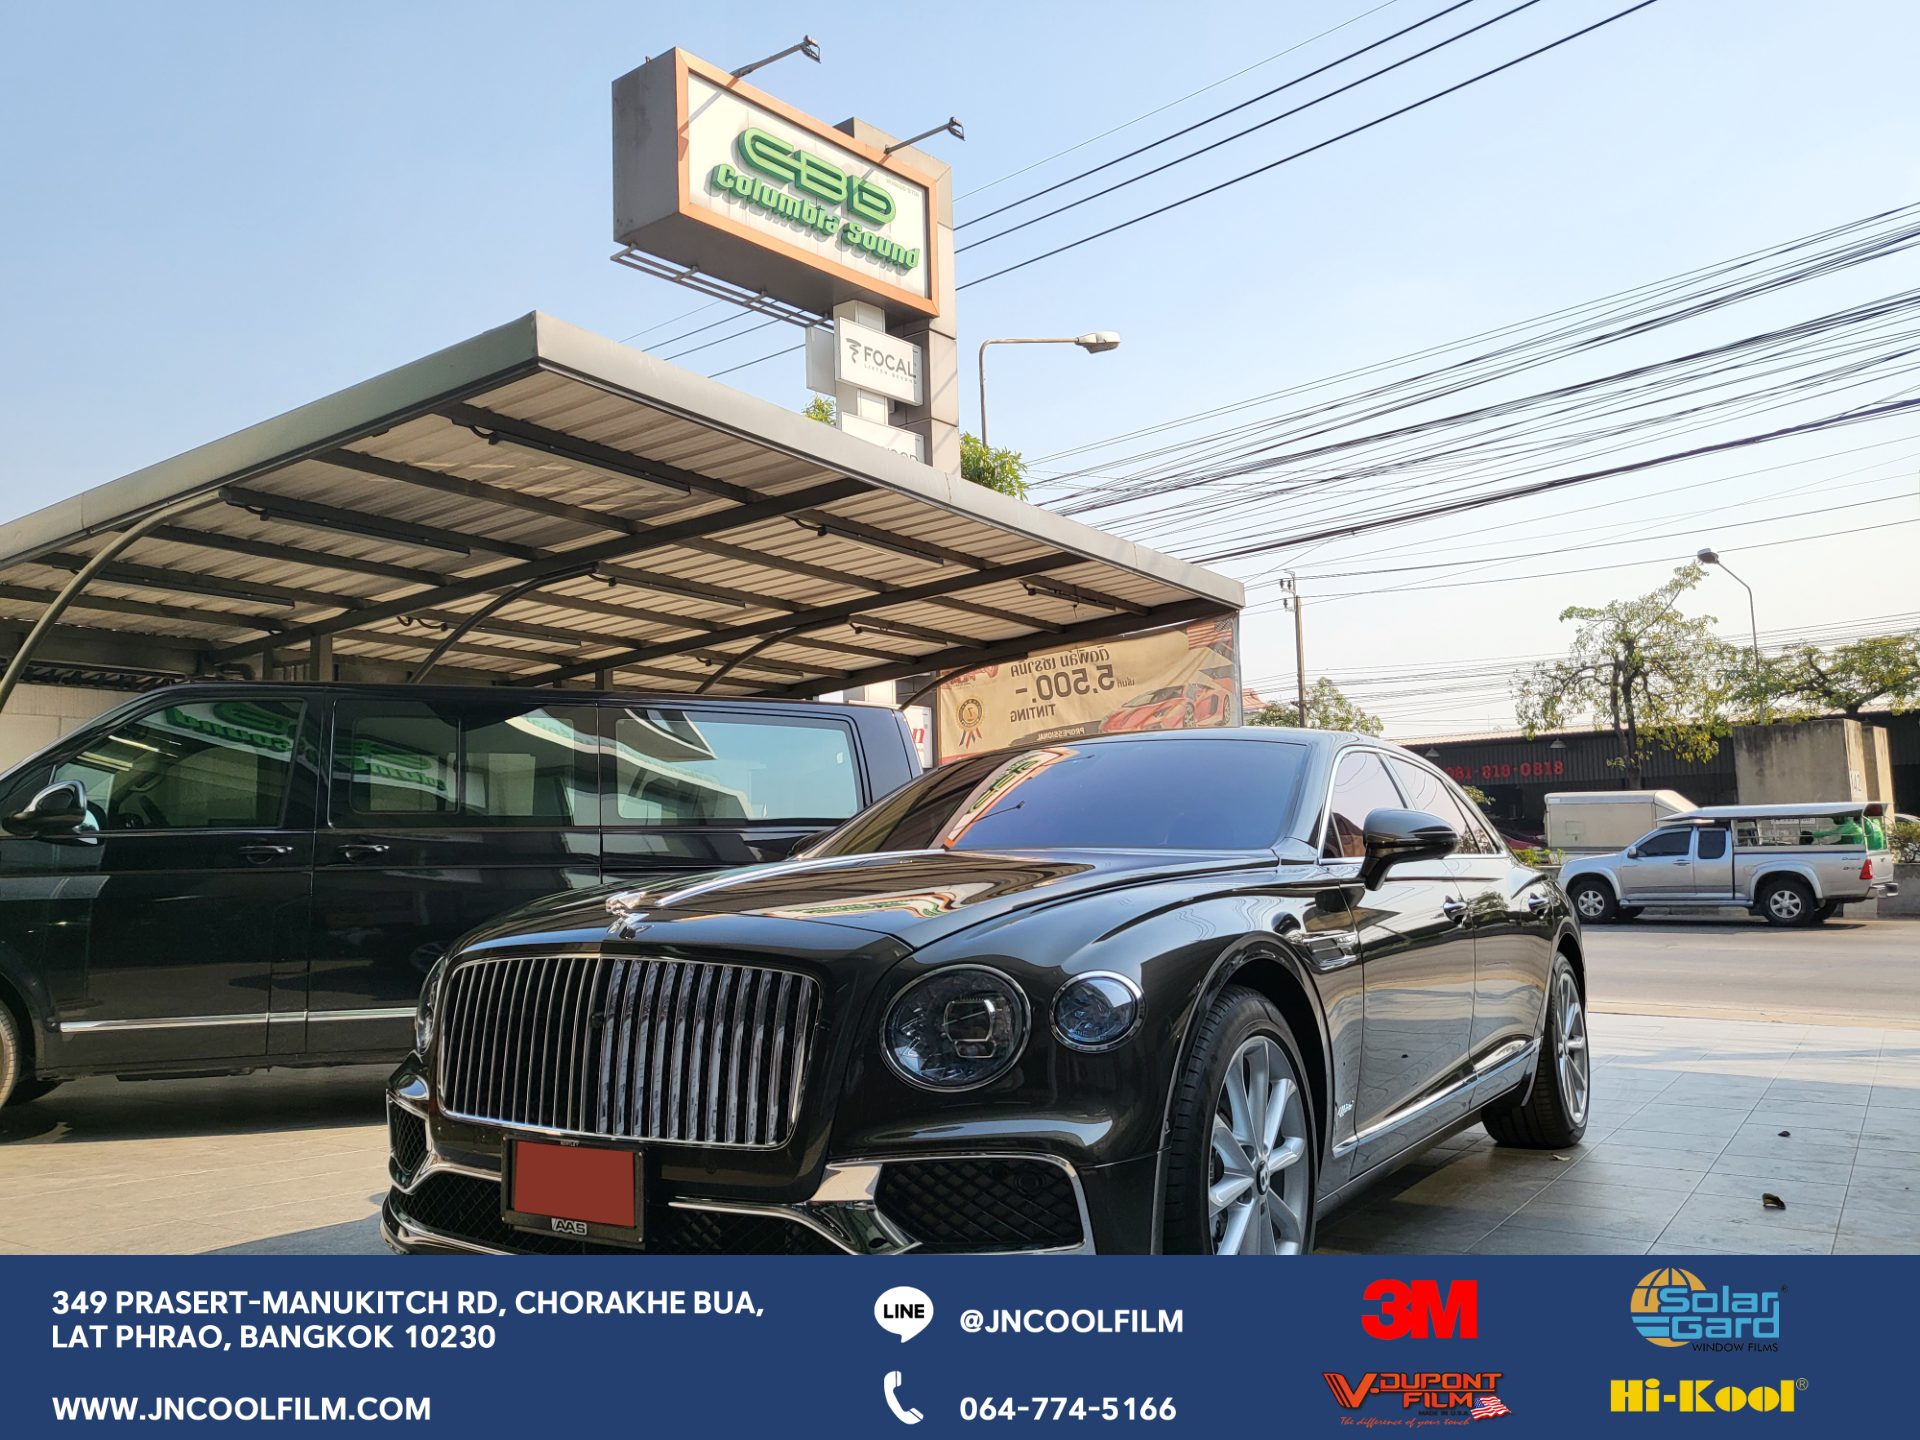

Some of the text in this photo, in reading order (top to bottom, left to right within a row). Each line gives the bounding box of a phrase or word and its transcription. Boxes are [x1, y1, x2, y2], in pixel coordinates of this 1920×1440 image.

[712, 164, 920, 270] Columbia Sound
[864, 346, 917, 378] FOCAL
[554, 1220, 587, 1234] AAS
